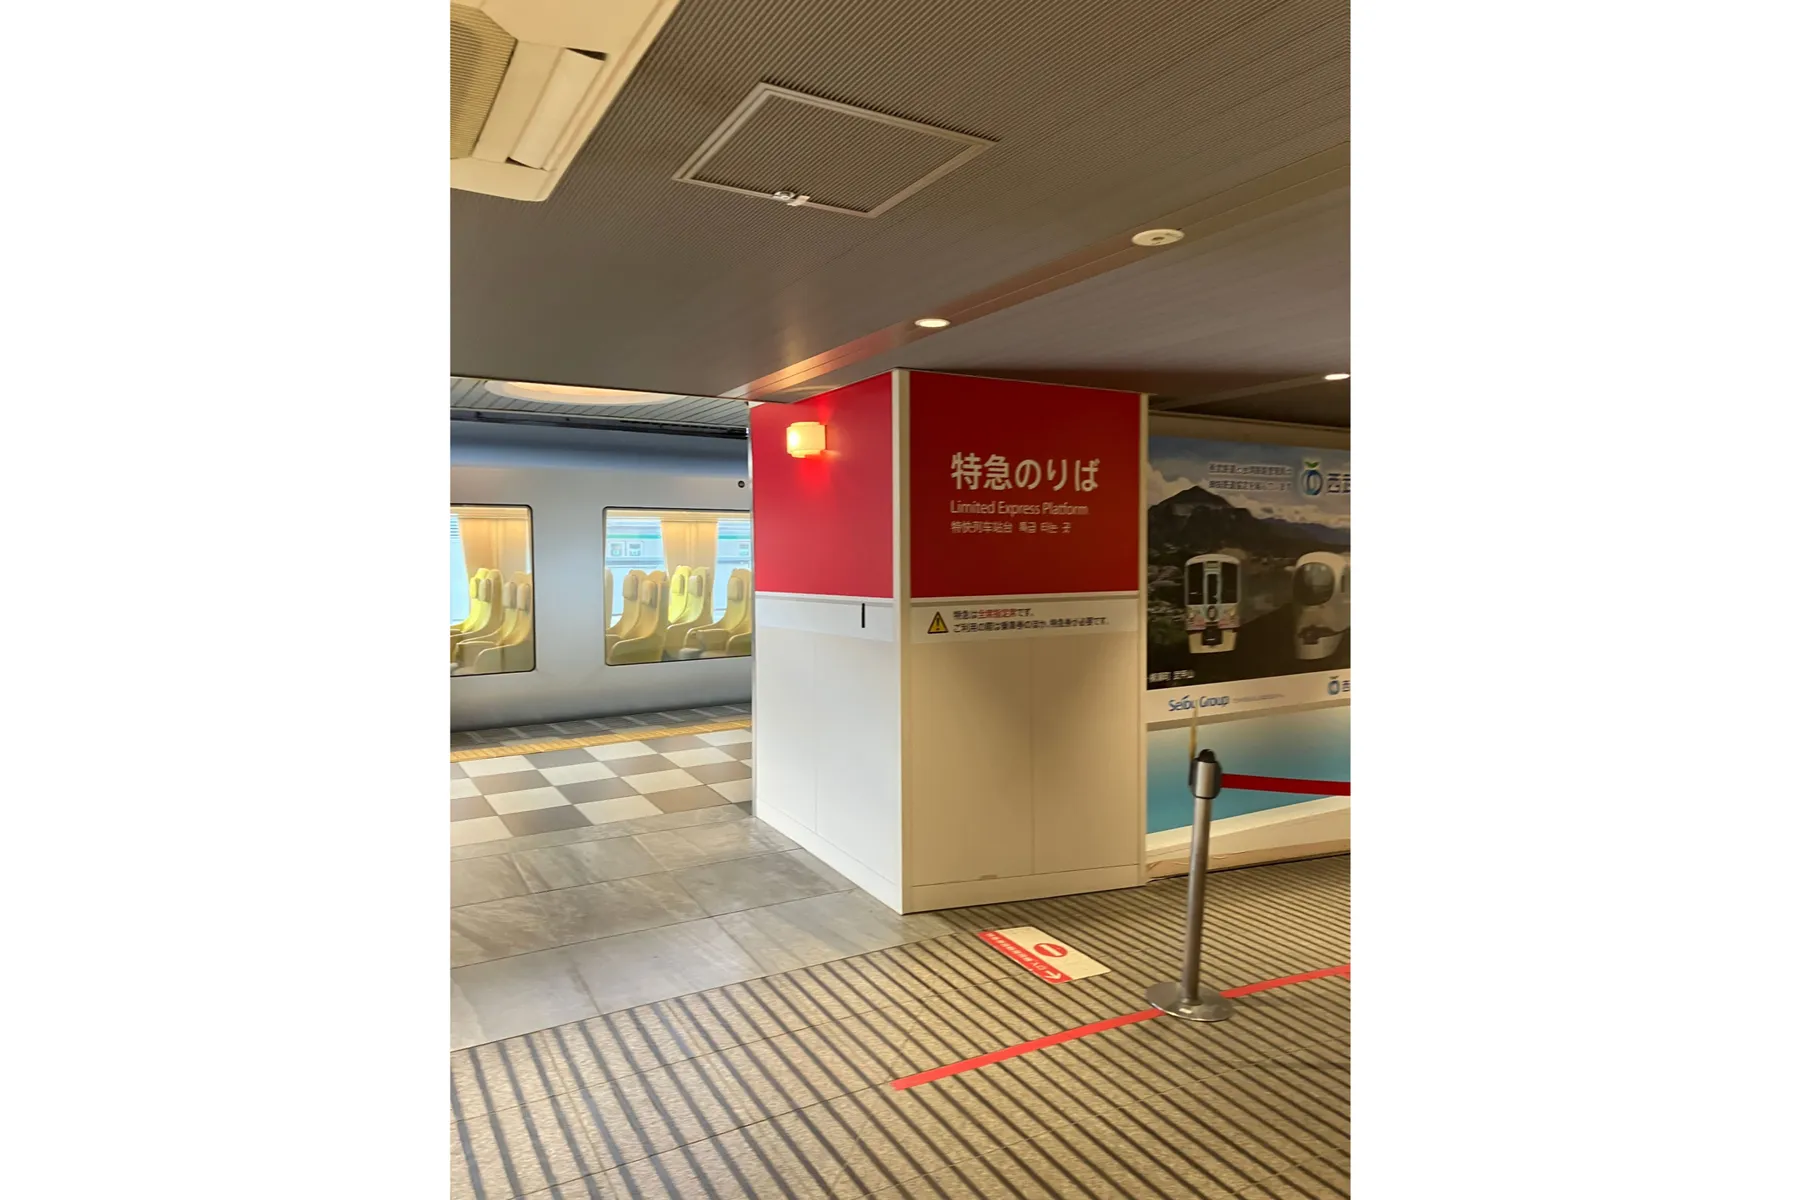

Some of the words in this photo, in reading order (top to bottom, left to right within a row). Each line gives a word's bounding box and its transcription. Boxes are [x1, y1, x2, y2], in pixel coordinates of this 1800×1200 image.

[951, 452, 1100, 491] 特急のりば
[950, 500, 996, 514] Limited
[998, 501, 1040, 517] Express
[1042, 501, 1089, 515] Platform
[1199, 695, 1230, 708] Group
